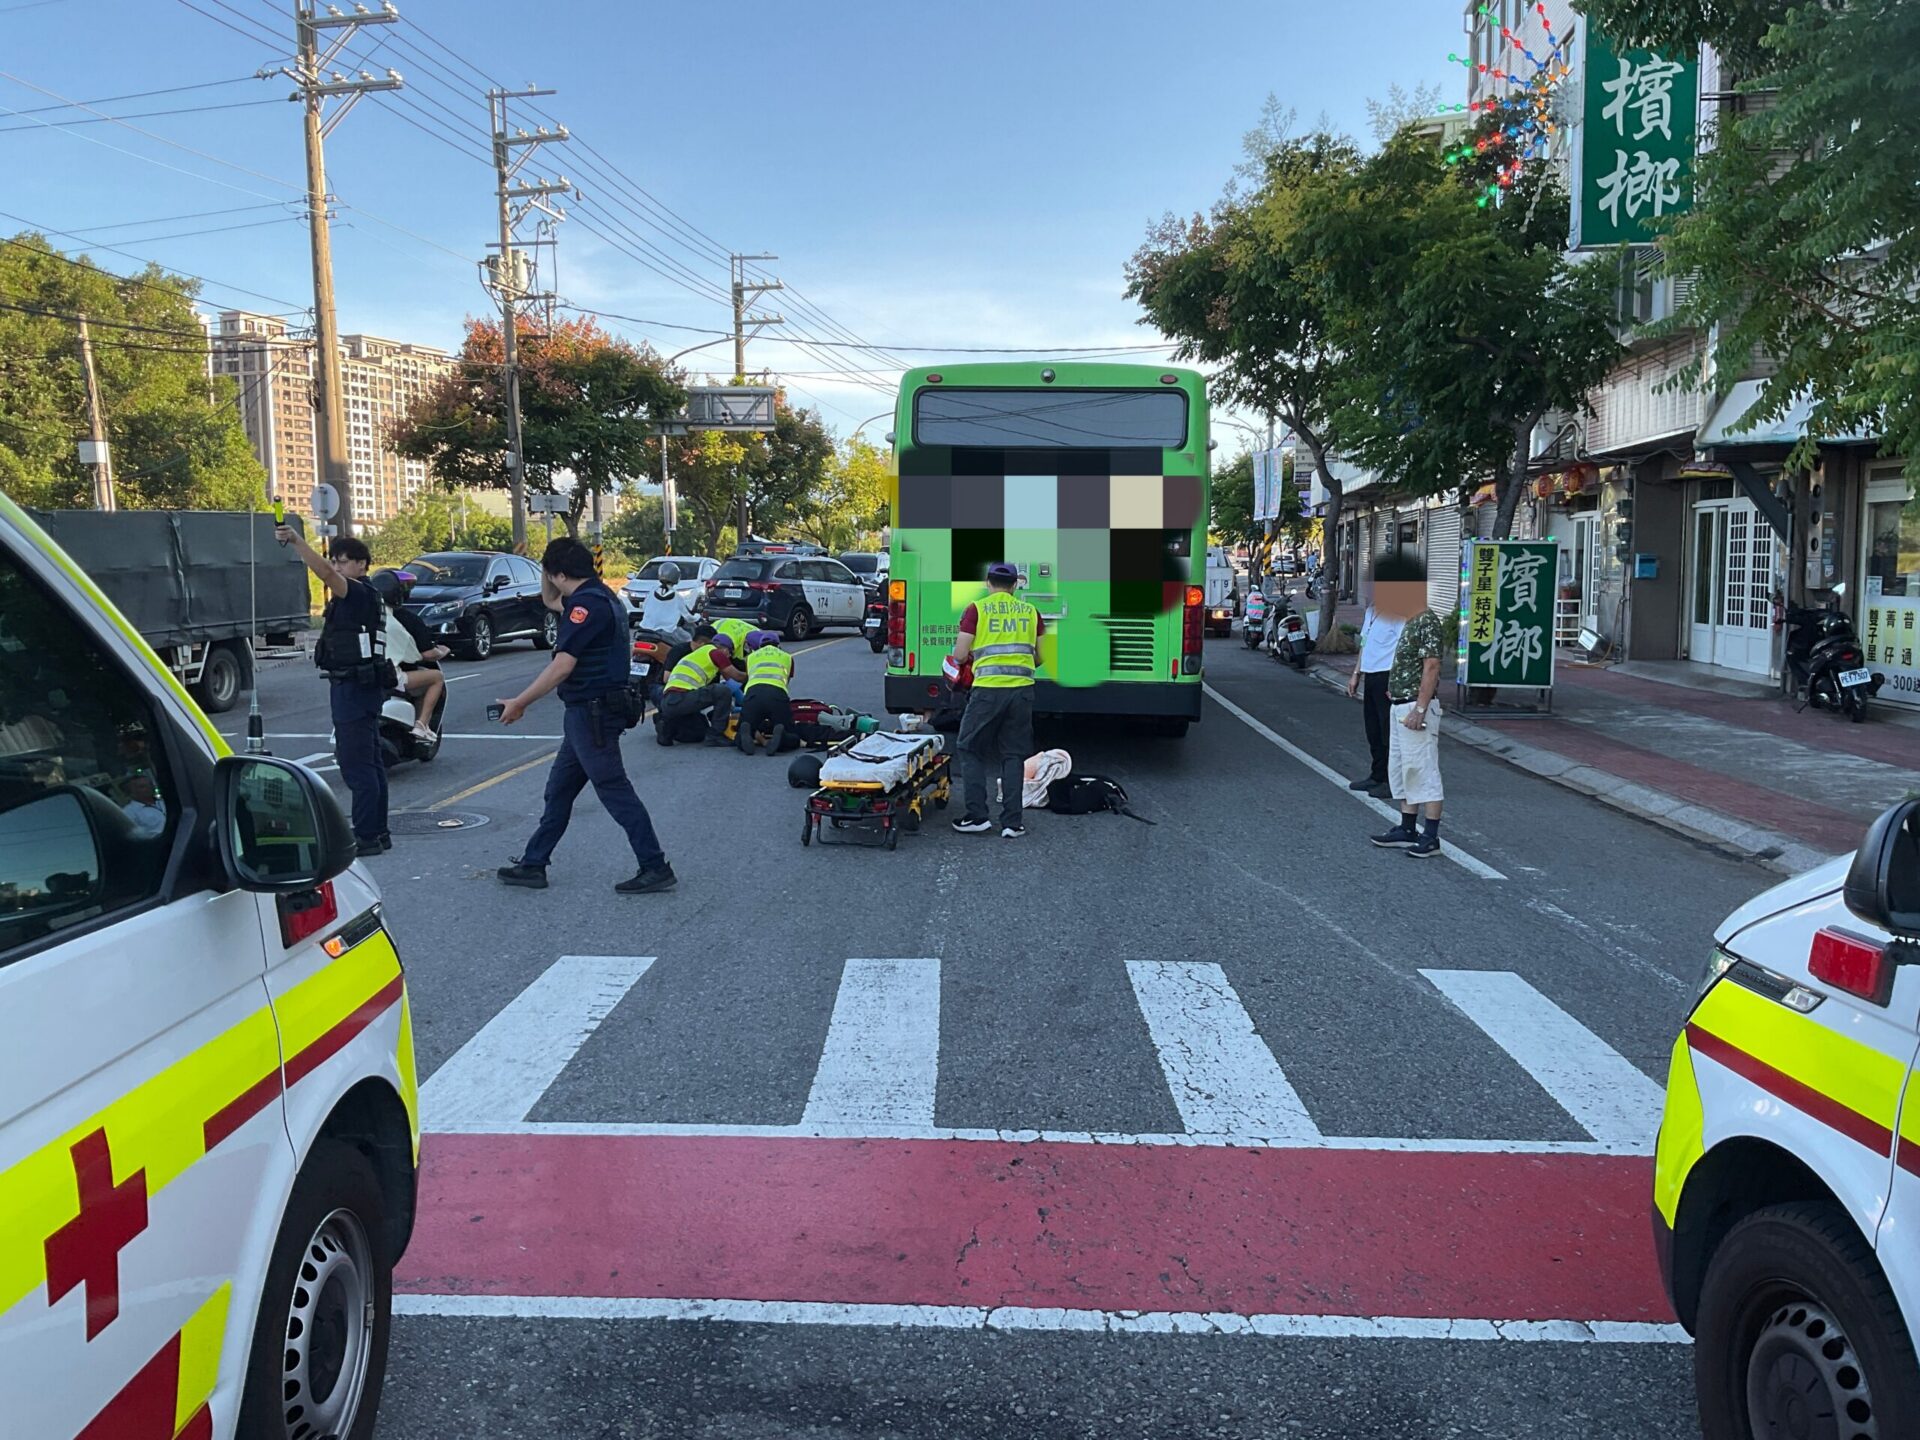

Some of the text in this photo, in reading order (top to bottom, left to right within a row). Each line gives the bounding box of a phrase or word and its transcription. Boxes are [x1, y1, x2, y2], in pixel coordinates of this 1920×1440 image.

[1596, 52, 1685, 232] 檳榔
[1476, 548, 1495, 592] 雙子星
[817, 597, 829, 608] 174
[983, 601, 1033, 615] 桃園消防
[989, 618, 1030, 633] EMT
[1473, 596, 1492, 639] 結冰水
[1480, 547, 1548, 680] 檳榔
[1866, 609, 1879, 662] 雙子星
[1884, 610, 1897, 664] 菁仔
[1901, 611, 1915, 666] 普通
